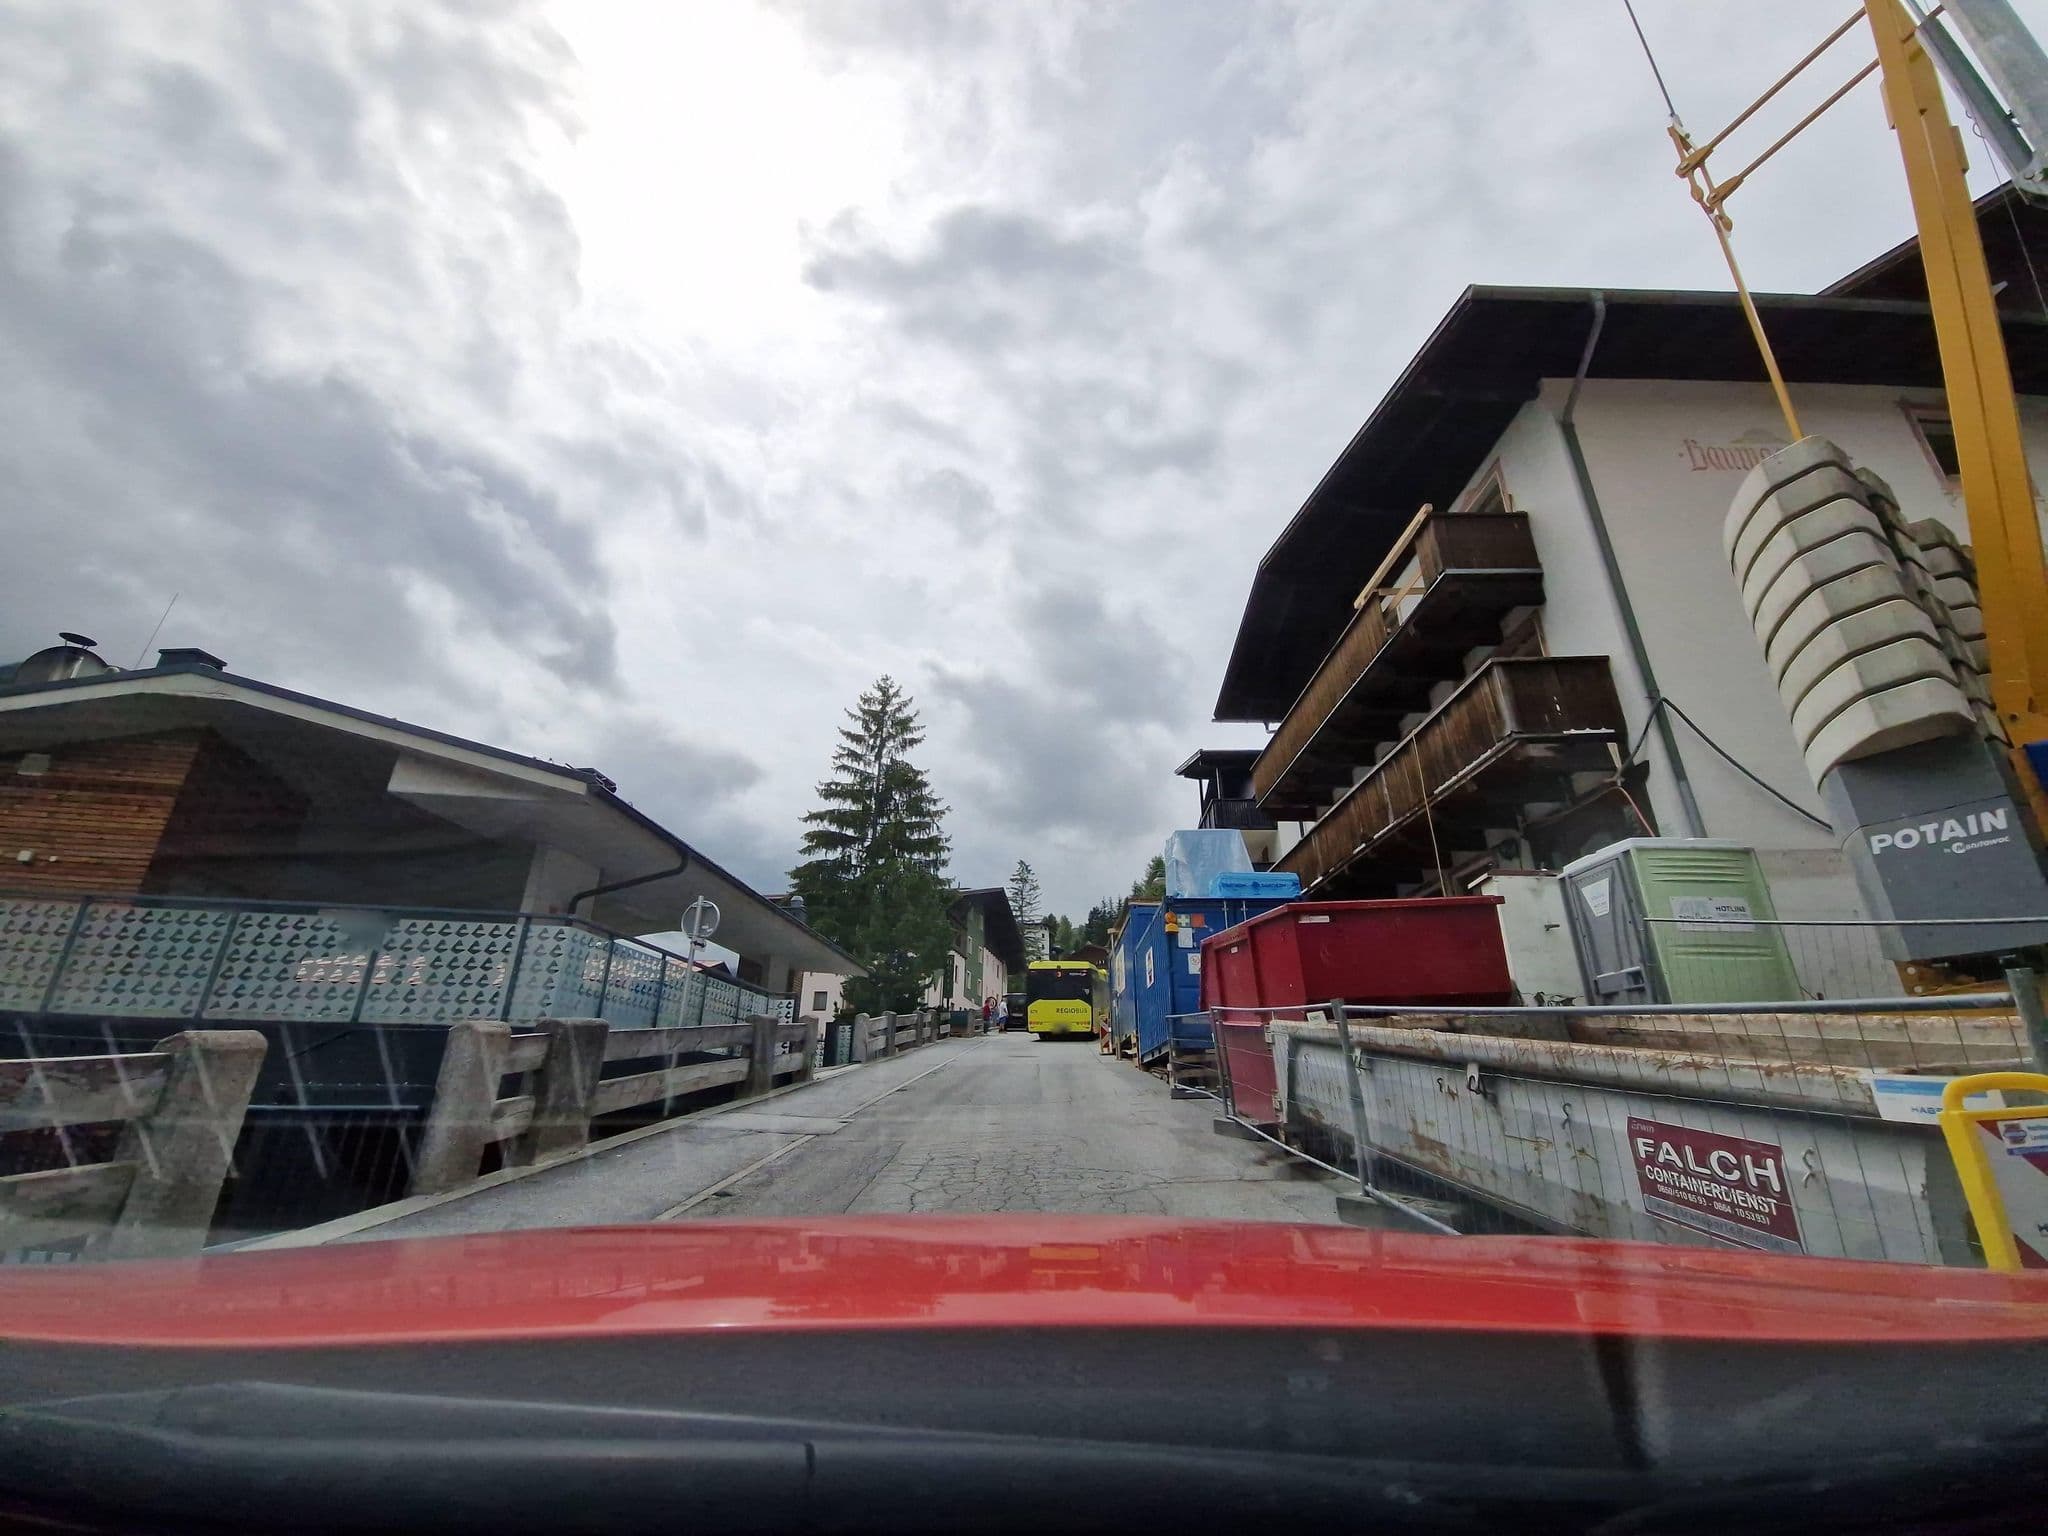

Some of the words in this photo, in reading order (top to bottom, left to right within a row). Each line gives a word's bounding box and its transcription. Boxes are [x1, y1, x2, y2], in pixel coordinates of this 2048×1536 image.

[1870, 808, 2008, 855] POTAIN
[1715, 905, 1746, 913] HOTLINE
[1636, 1138, 1782, 1193] FALCH
[1645, 1165, 1778, 1216] CONTAINERDIENST
